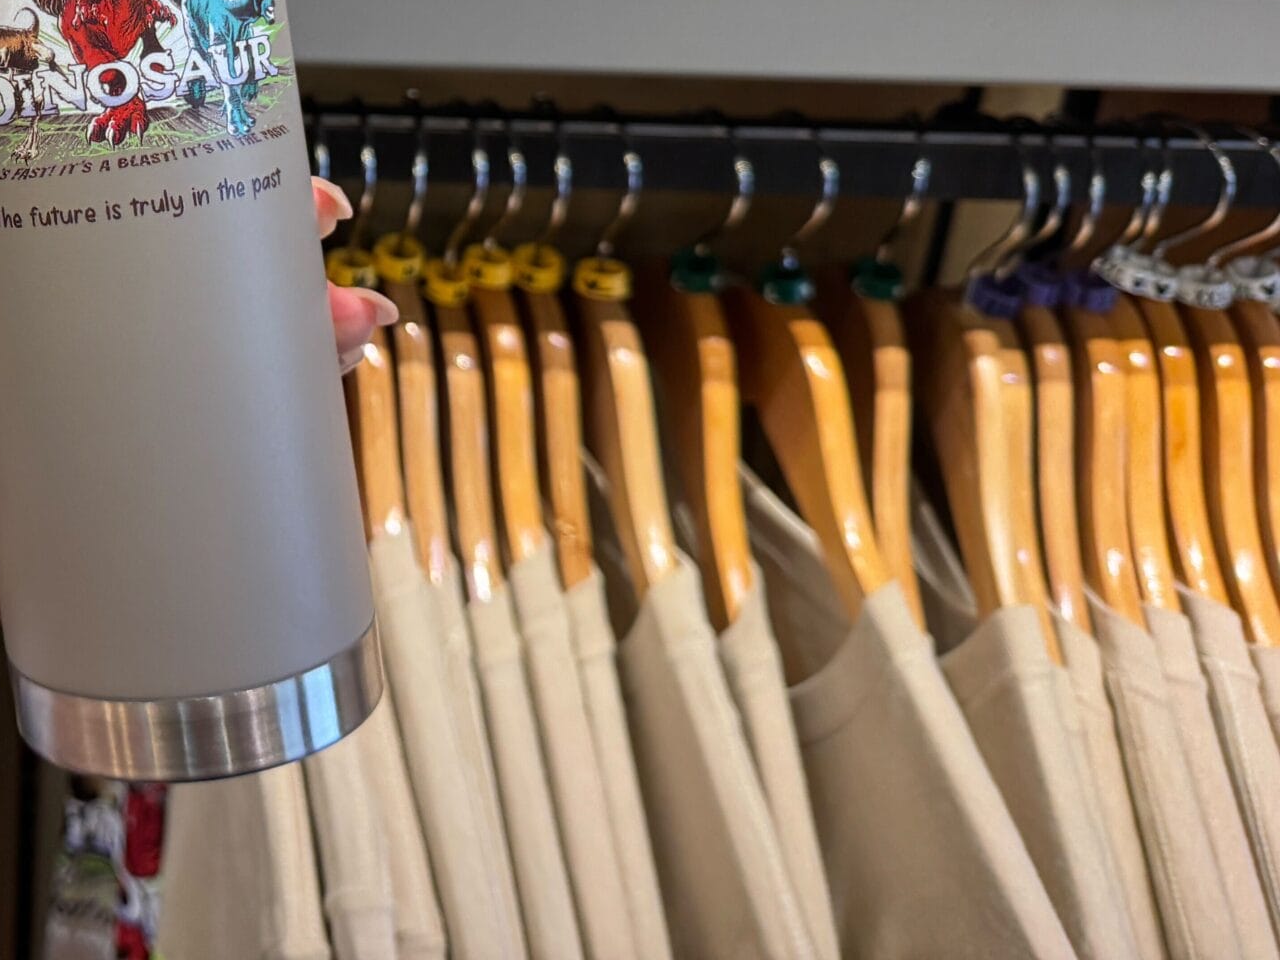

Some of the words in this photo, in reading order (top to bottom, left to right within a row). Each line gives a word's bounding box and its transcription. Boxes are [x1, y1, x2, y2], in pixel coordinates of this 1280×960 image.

[11, 165, 56, 180] FAST!
[59, 160, 93, 176] IT'S
[99, 159, 111, 172] A
[117, 149, 178, 168] BLAST!
[182, 143, 215, 158] IT'S
[216, 139, 234, 151] IN
[30, 206, 96, 227] future
[105, 200, 122, 220] is
[130, 189, 184, 218] truly
[192, 187, 210, 207] in
[217, 178, 246, 201] the
[252, 167, 281, 200] past
